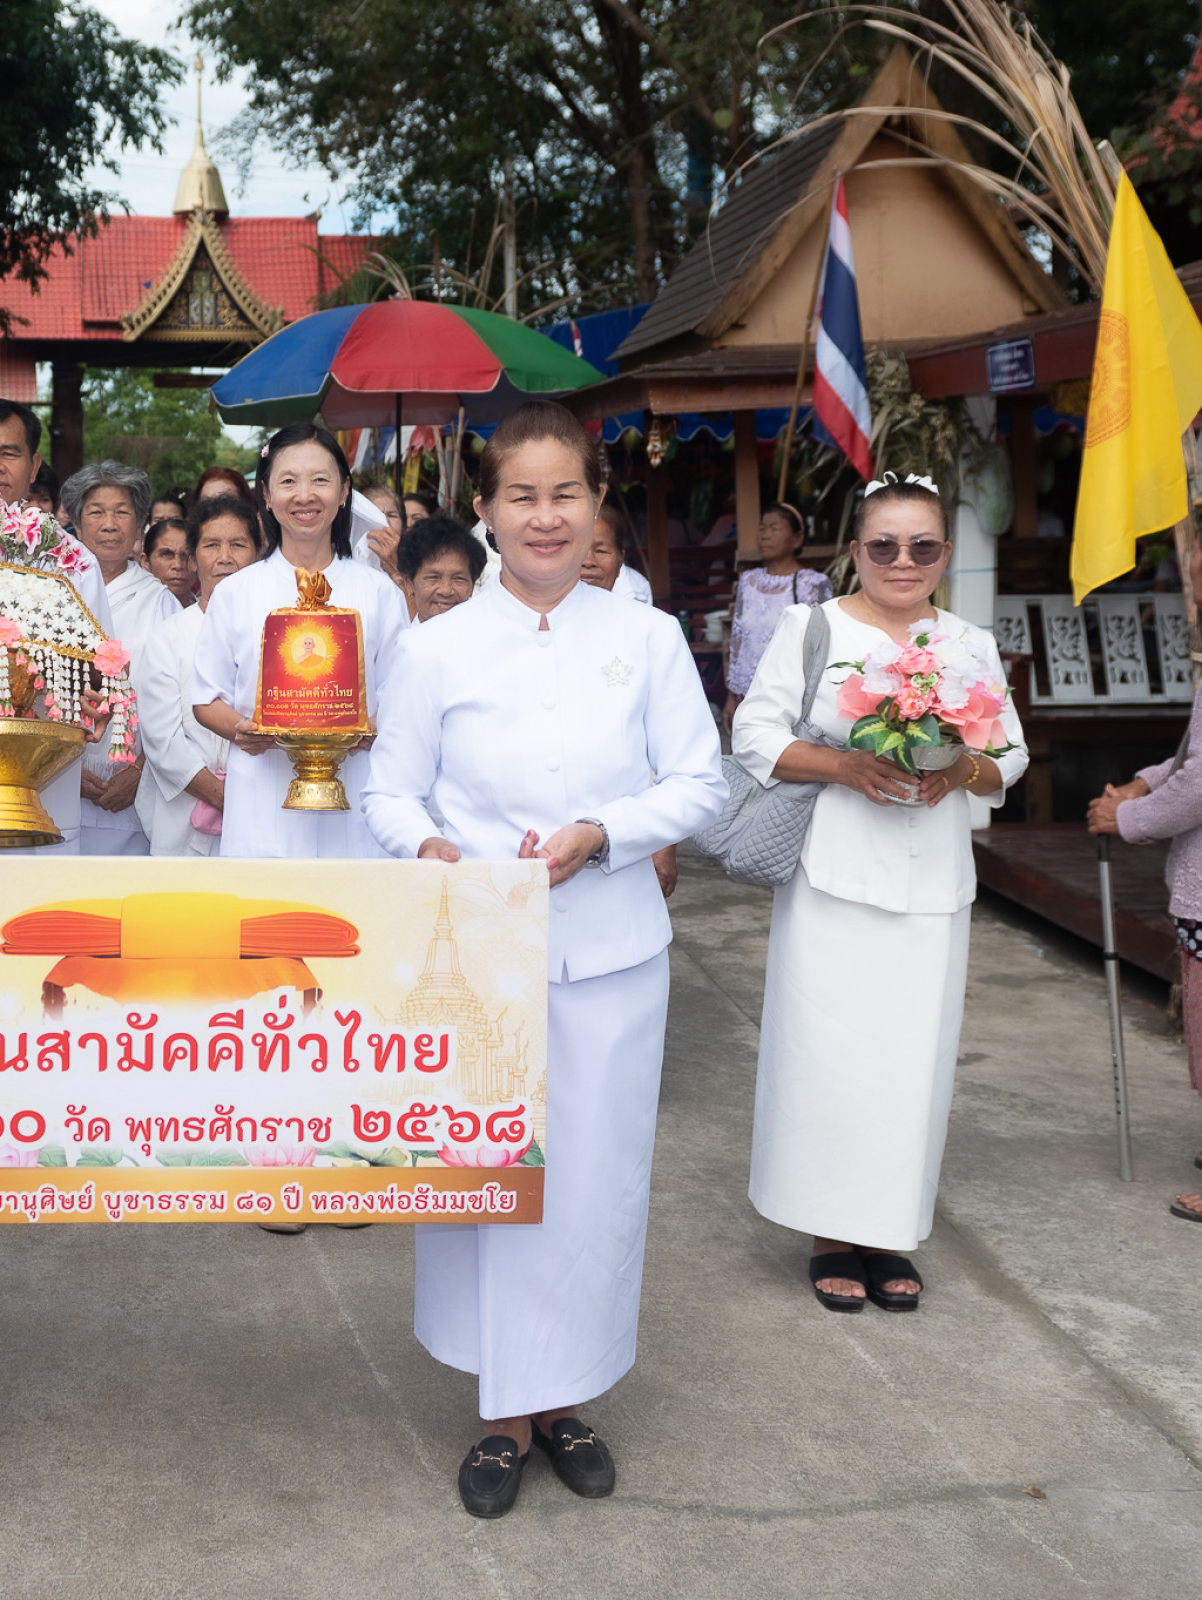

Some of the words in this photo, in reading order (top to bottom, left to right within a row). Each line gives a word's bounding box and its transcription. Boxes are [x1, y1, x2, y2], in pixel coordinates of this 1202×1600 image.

[64, 1104, 111, 1142] วัด
[125, 1104, 332, 1157] พุทธศักราช
[350, 1102, 526, 1143] ๒๕๖๘
[104, 1193, 225, 1220] บูชาธรรม
[236, 1193, 273, 1213] ๘๑
[284, 1186, 301, 1211] ปี
[311, 1185, 516, 1212] หลวงพ่อธัมมชโย
